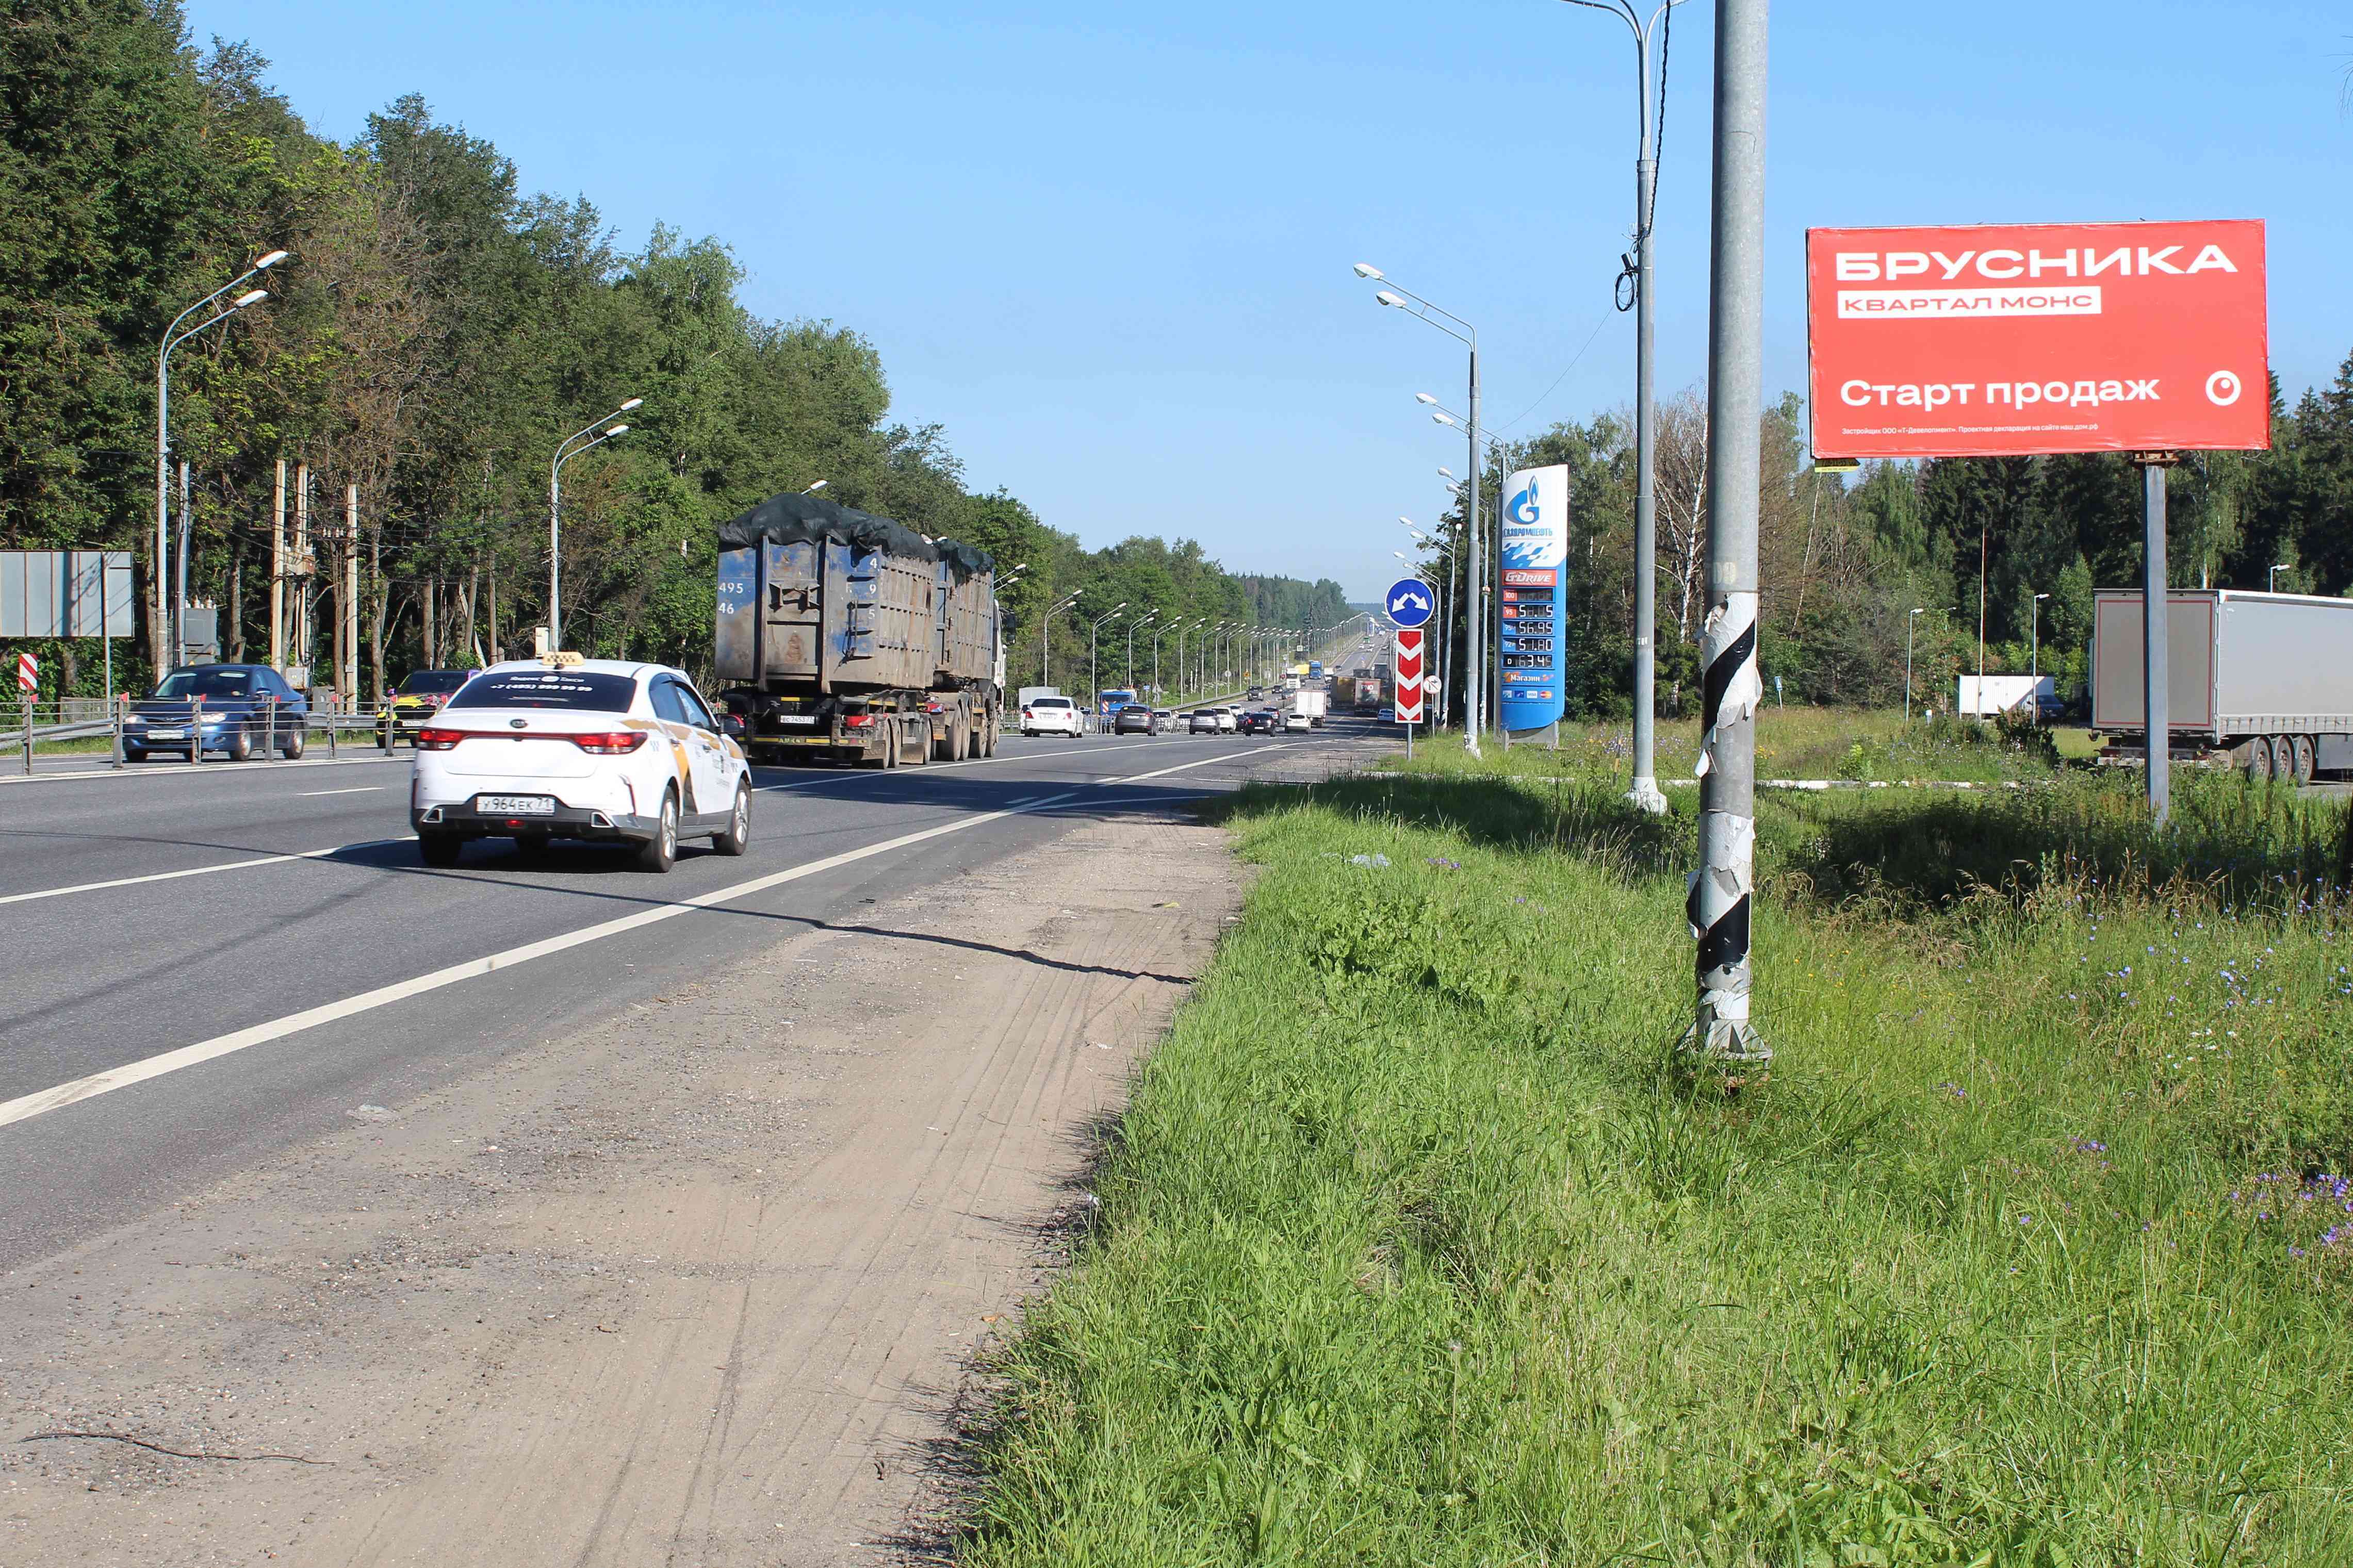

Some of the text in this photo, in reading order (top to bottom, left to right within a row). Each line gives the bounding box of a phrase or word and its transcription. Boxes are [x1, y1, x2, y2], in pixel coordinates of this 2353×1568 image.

[1836, 245, 2238, 280] БРУСНИКА
[1844, 295, 2093, 311] КВАРТАЛ МОНС
[1840, 379, 2161, 411] Старт продаж
[719, 582, 744, 594] 495
[718, 602, 734, 614] 46
[1519, 621, 1553, 634] 56.95
[1519, 638, 1553, 651] 51.80
